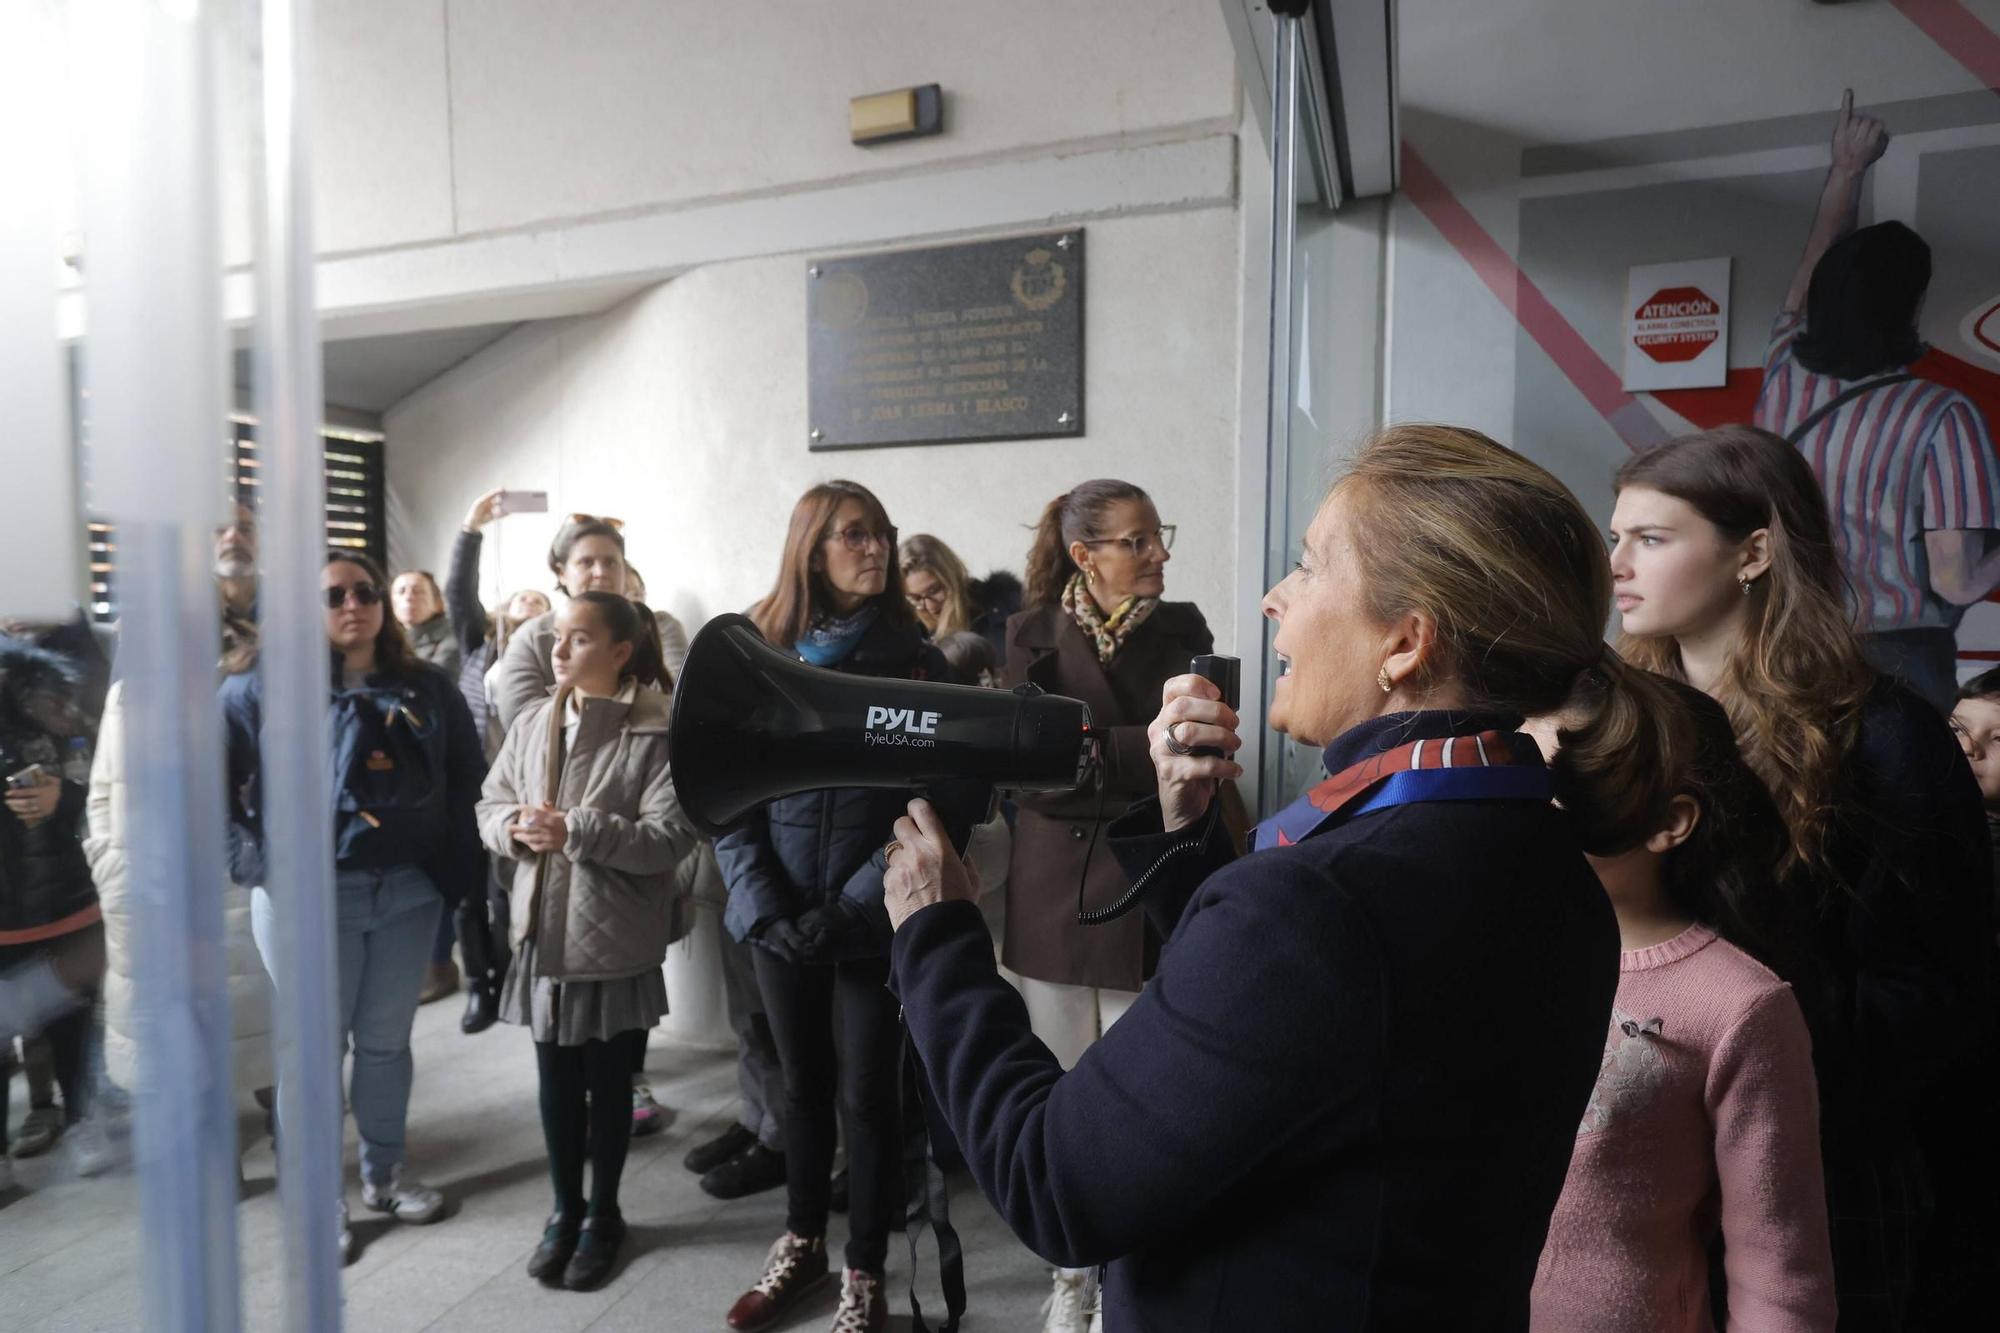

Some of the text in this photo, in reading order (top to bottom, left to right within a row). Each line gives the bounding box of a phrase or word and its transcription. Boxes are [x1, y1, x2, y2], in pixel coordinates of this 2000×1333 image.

[1643, 301, 1711, 318] ATENCIÓN
[1637, 332, 1715, 345] SECURITY SYSTEM
[976, 396, 1029, 414] BLASCO
[866, 705, 938, 734] PYLE
[865, 731, 935, 748] PyleUSA.com
